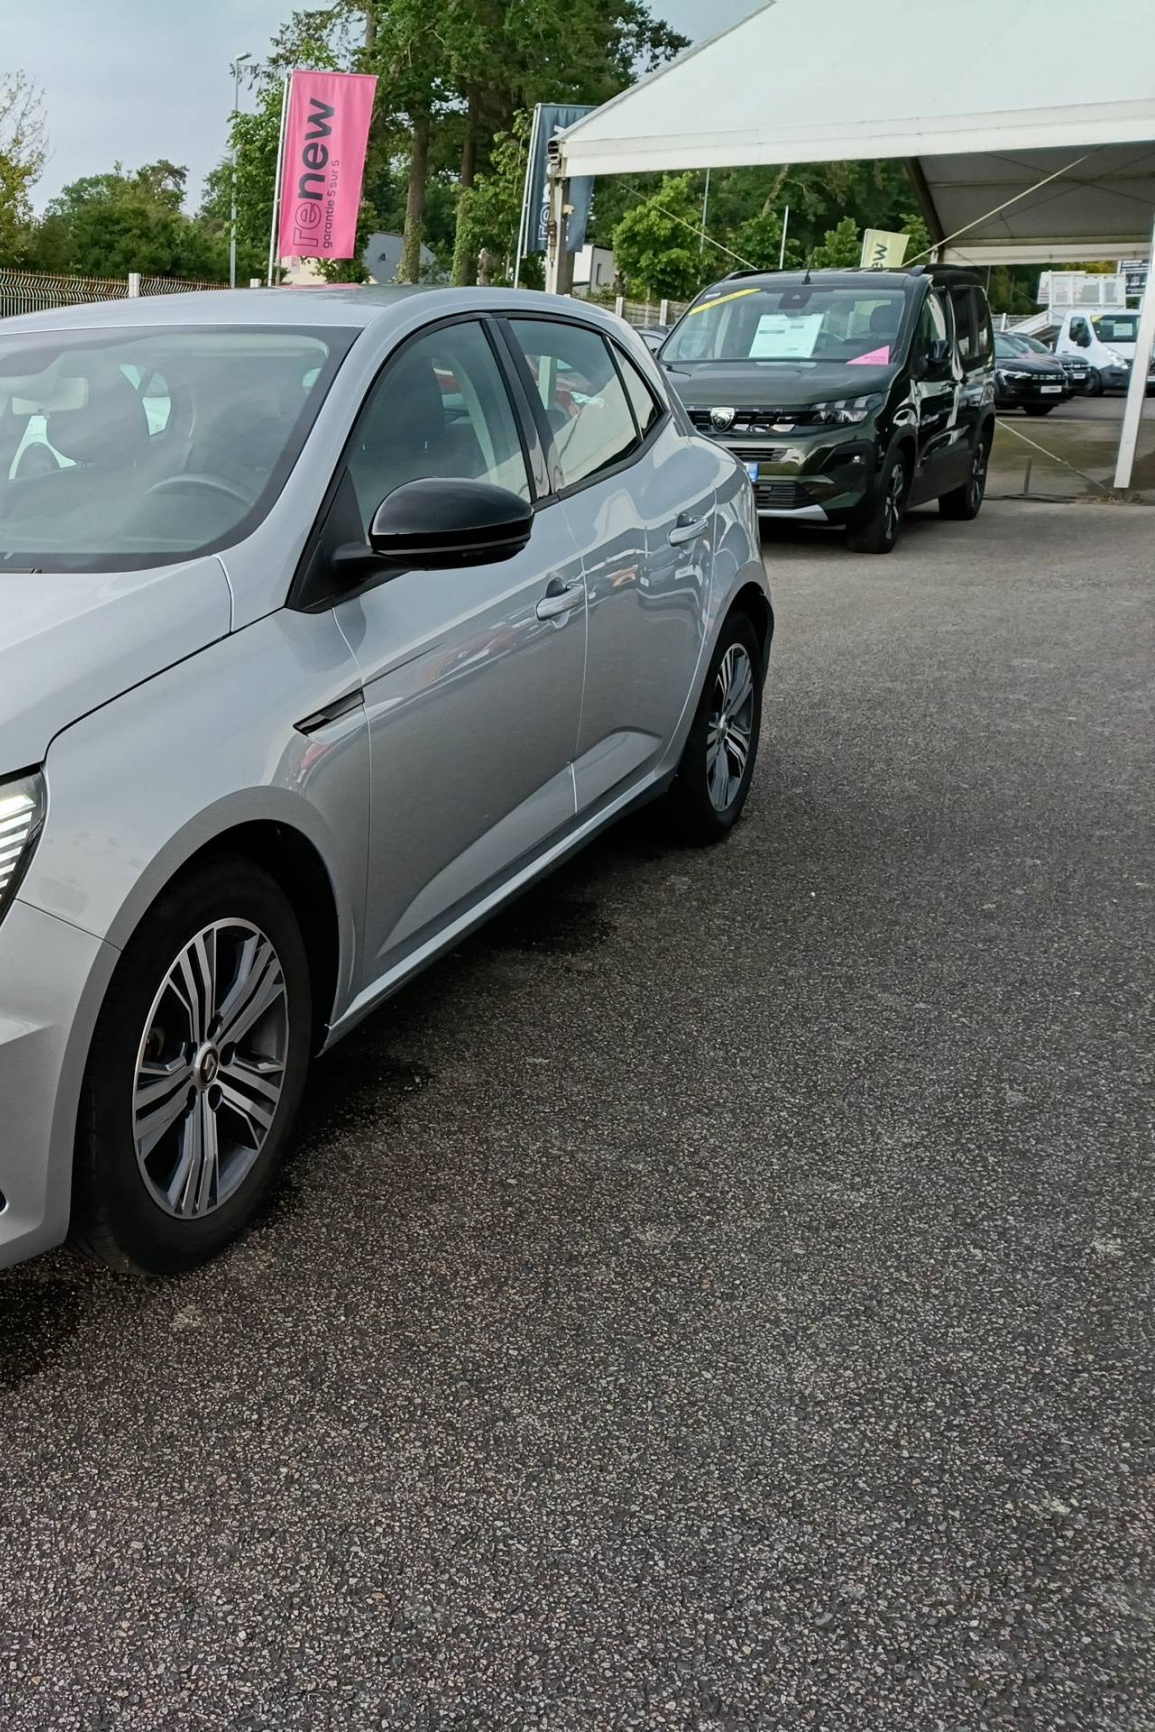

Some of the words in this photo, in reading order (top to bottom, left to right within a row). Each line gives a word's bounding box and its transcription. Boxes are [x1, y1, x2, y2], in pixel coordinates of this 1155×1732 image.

[293, 97, 335, 248] renew
[331, 159, 340, 167] 5
[331, 169, 339, 188] sur
[327, 189, 336, 197] 5
[323, 199, 336, 249] garantie
